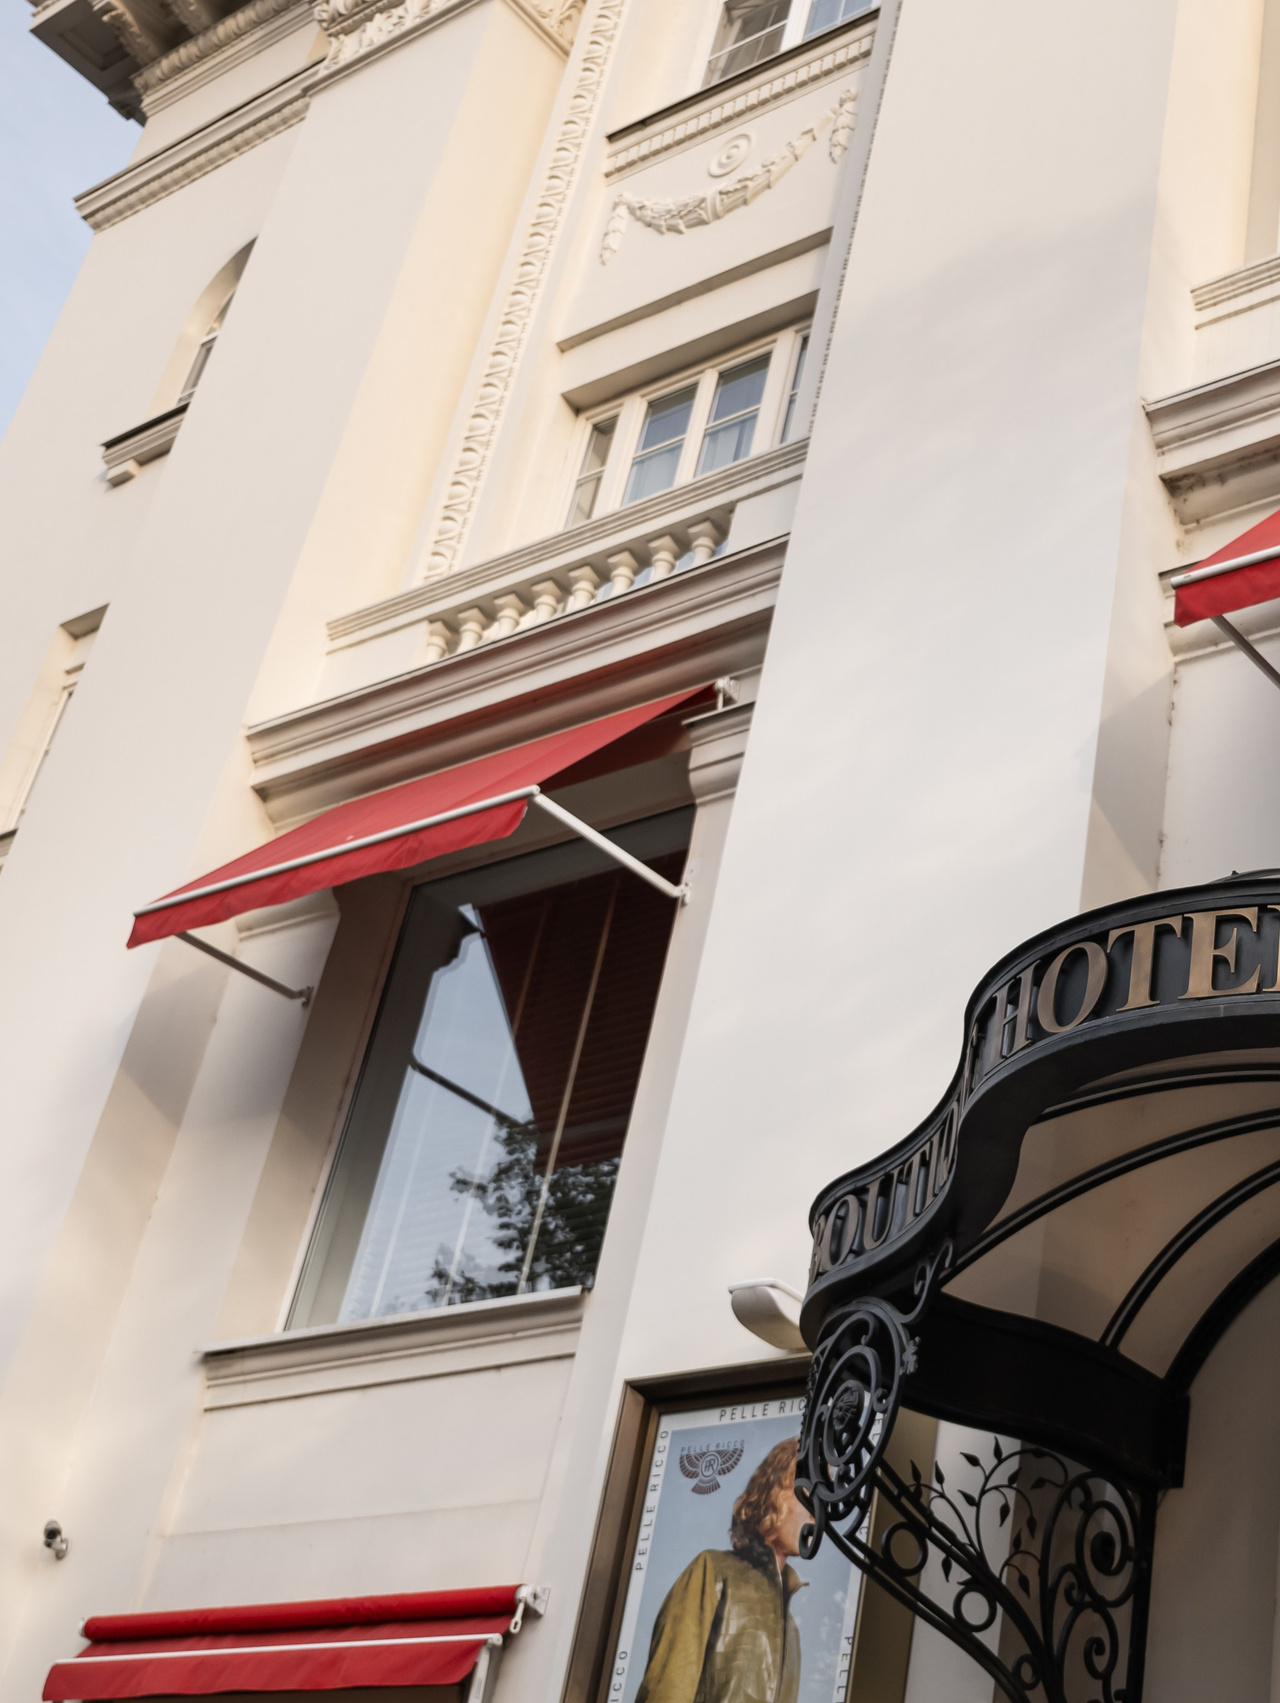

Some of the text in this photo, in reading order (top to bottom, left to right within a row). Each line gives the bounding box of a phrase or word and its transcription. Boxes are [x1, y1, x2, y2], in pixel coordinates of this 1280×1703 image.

[808, 1022, 978, 1287] BOUTIQ
[718, 1398, 808, 1422] PELLE RIC
[680, 1439, 746, 1455] PELLE RICCO
[635, 1429, 670, 1571] PELLE RICCO
[610, 1650, 629, 1703] ICCO
[835, 1636, 853, 1703] PELL
